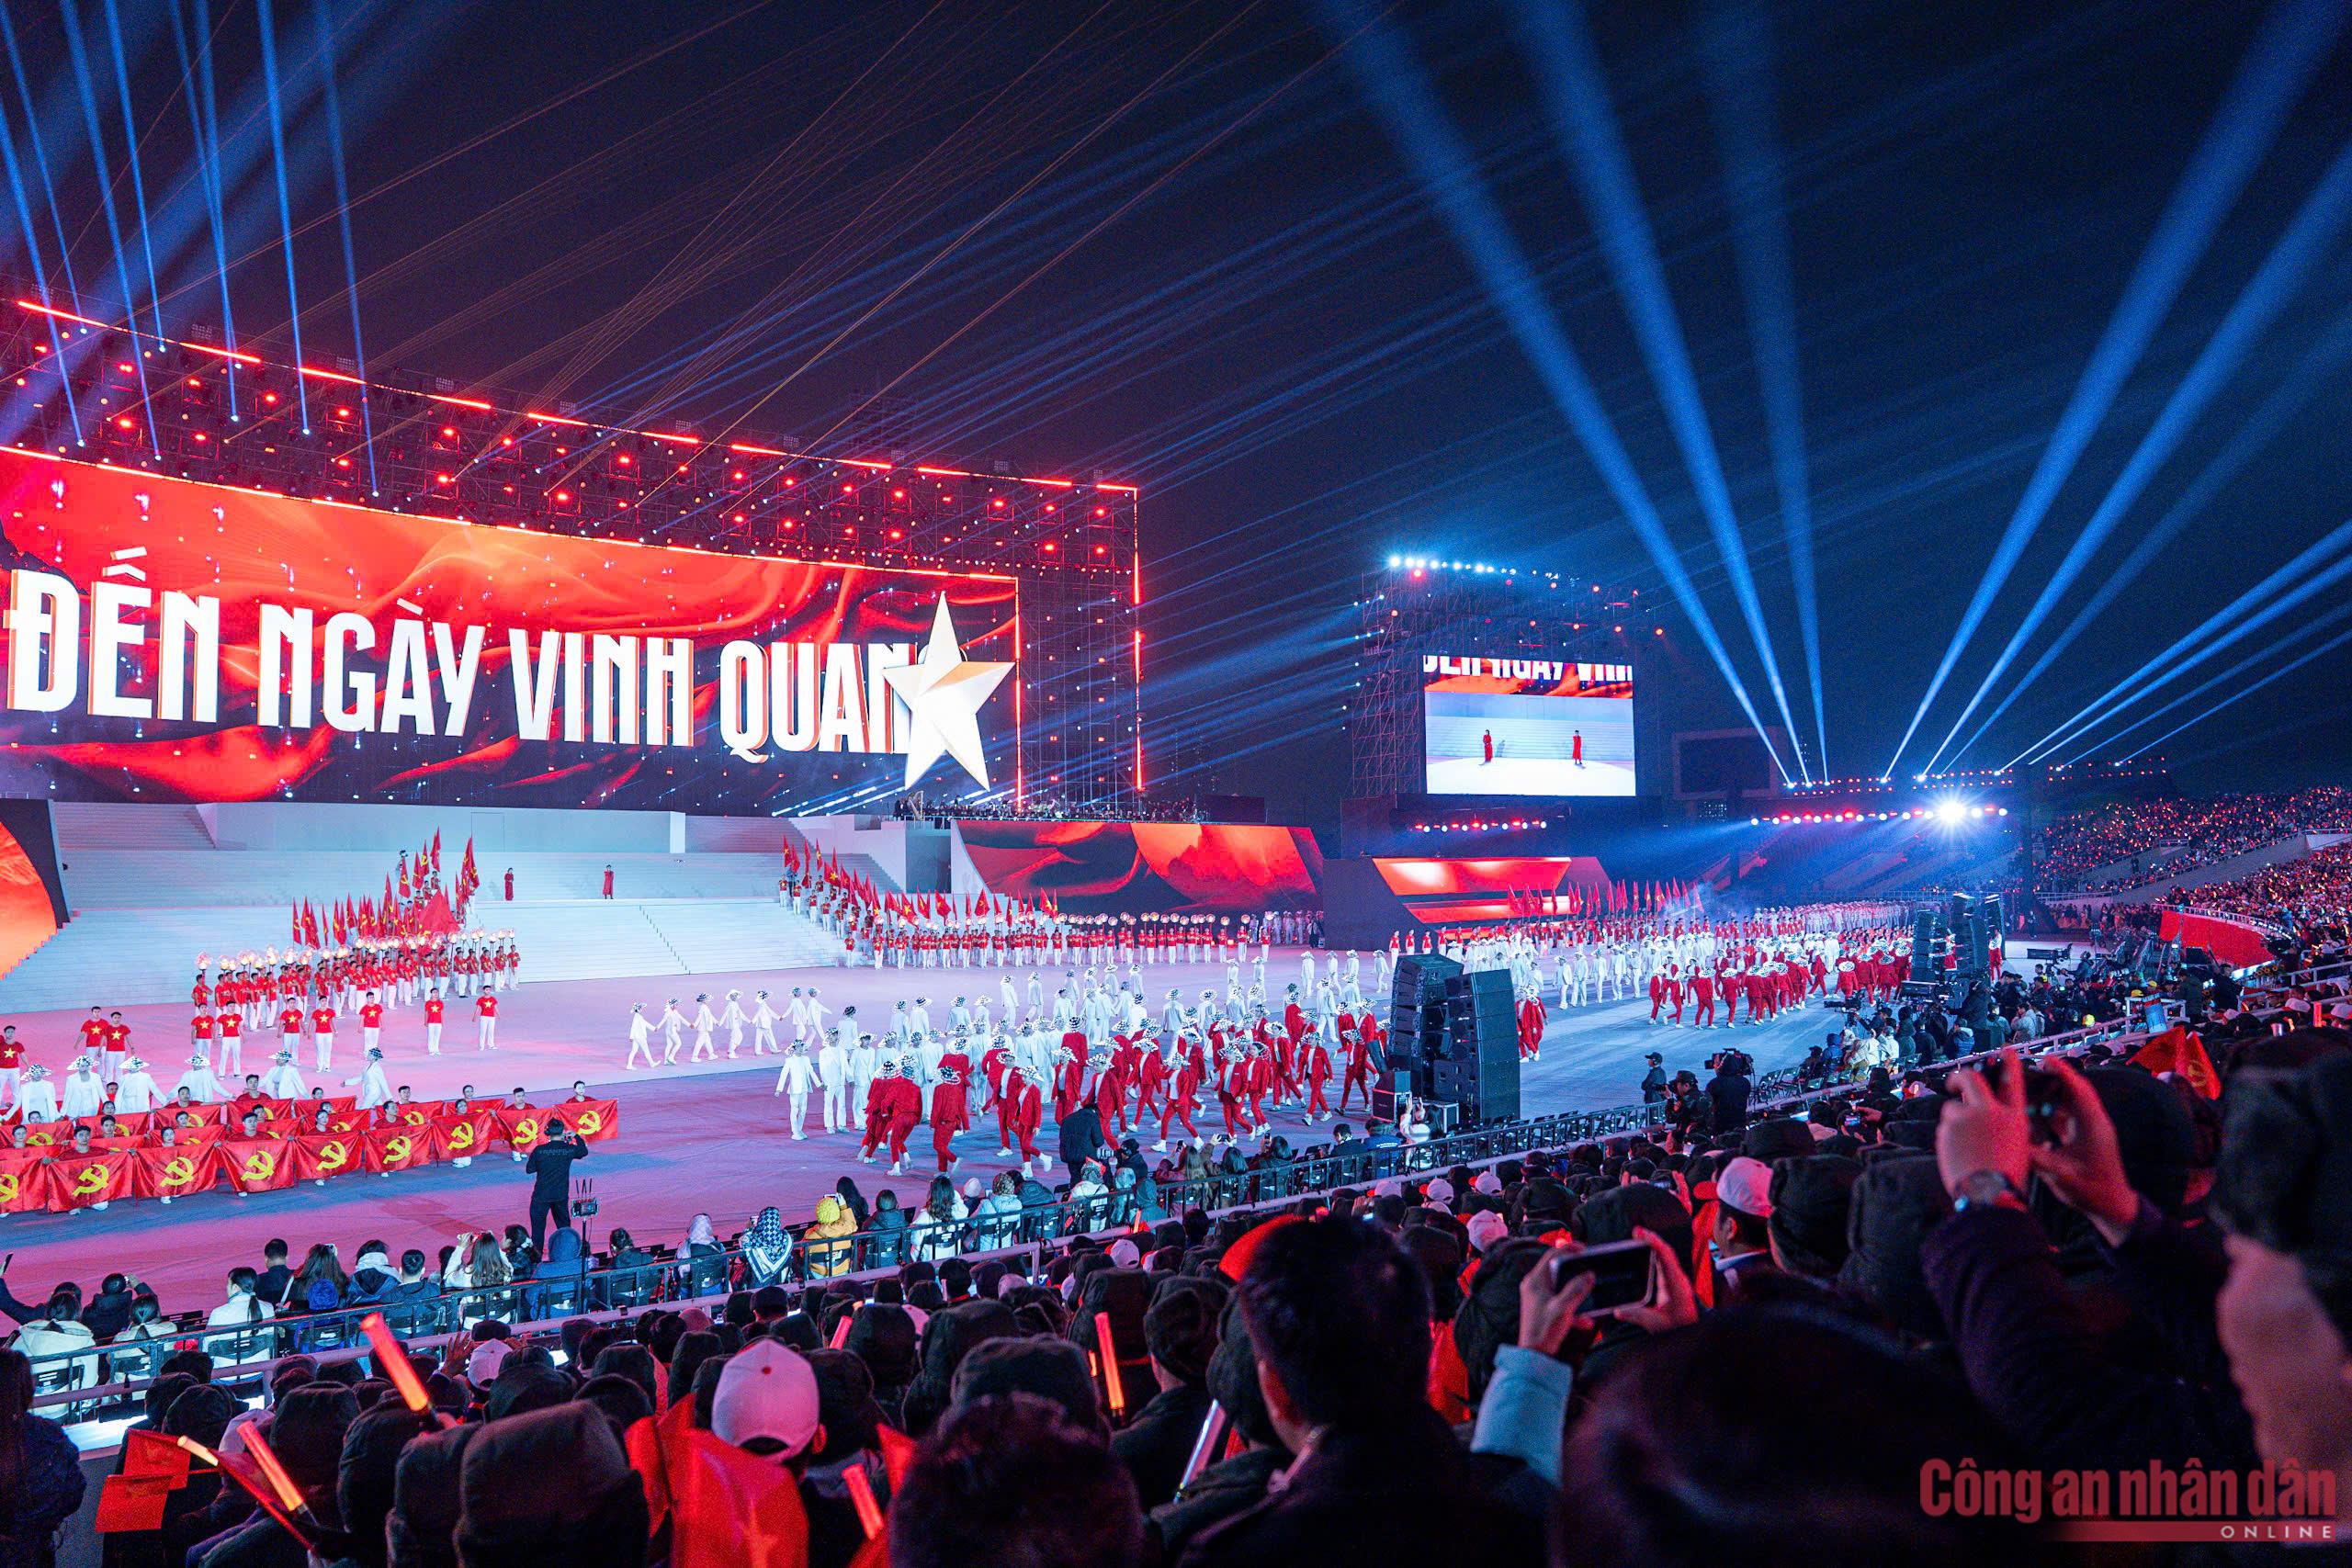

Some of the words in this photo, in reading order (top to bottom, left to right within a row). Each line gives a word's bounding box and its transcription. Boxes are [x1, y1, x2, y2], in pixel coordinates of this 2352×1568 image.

[3, 547, 220, 722] ĐẾN
[257, 597, 486, 737] NGÀY
[508, 627, 695, 747] VINH
[719, 639, 968, 764] QUAN
